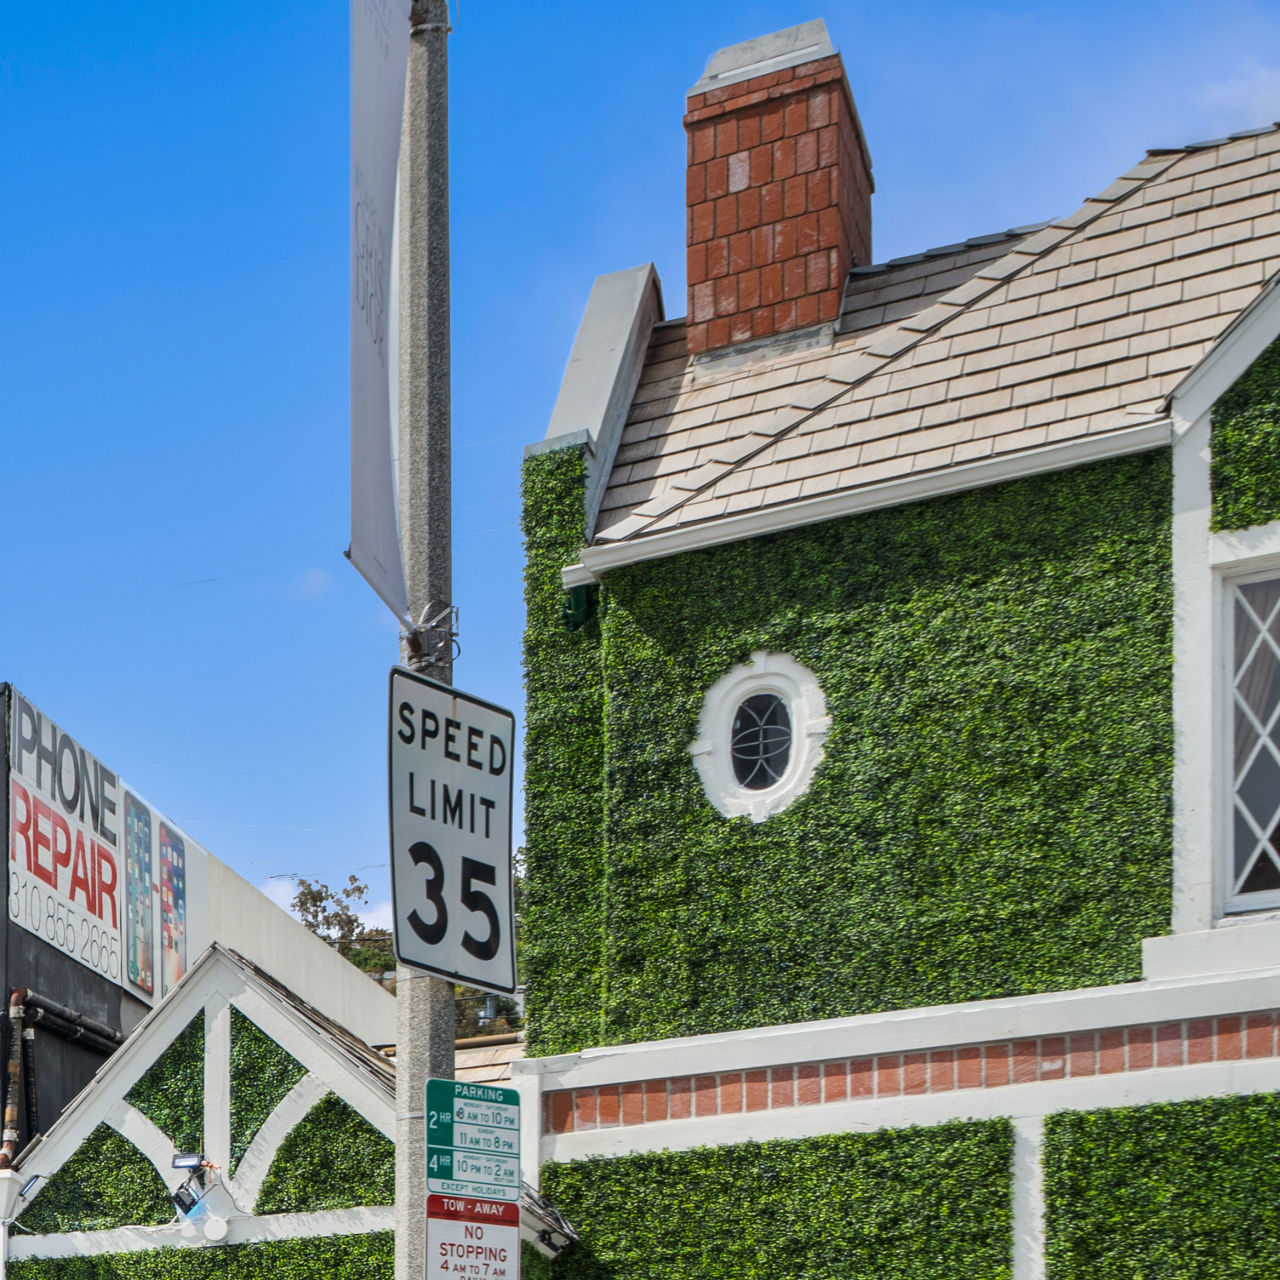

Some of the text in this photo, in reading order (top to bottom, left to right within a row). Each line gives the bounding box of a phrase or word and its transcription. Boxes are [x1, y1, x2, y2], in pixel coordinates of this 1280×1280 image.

[397, 701, 507, 777] SPEED
[409, 771, 496, 839] LIMIT
[10, 778, 118, 930] REPAIR
[407, 841, 500, 960] 35
[9, 872, 119, 979] 310 855 2665
[455, 1085, 504, 1101] PARKING
[429, 1111, 452, 1128] 2 HR
[480, 1113, 489, 1122] TO
[492, 1112, 502, 1124] 10
[504, 1117, 515, 1125] PM
[469, 1137, 480, 1145] AM
[483, 1138, 491, 1147] TO
[494, 1137, 500, 1149] 8
[503, 1141, 513, 1149] PM
[429, 1155, 451, 1172] 4 HR
[457, 1161, 515, 1177] 10 PM TO 2 AM
[441, 1182, 506, 1197] EXCEPT HOLIDAYS
[442, 1198, 466, 1212] TOW
[475, 1202, 505, 1216] AWAY
[464, 1225, 484, 1240] NO
[440, 1242, 507, 1262] STOPPING
[441, 1260, 506, 1277] 4 AM TO 7 AM
